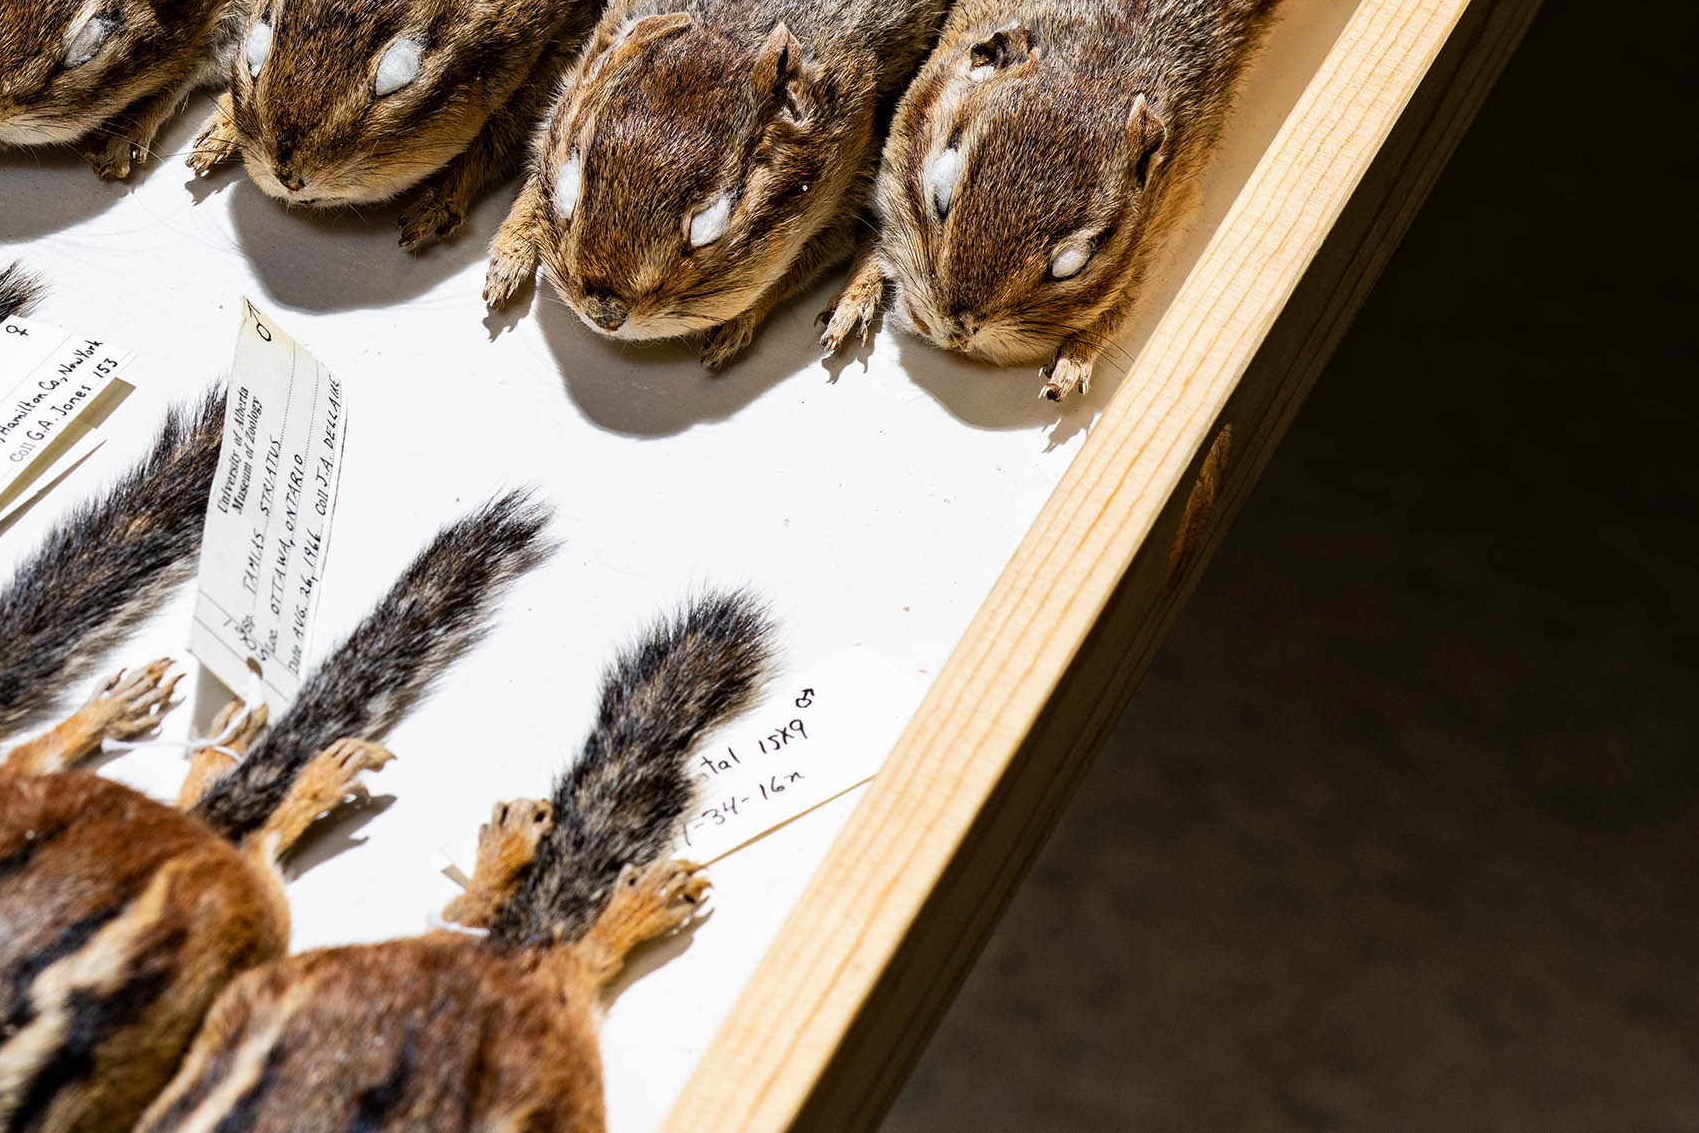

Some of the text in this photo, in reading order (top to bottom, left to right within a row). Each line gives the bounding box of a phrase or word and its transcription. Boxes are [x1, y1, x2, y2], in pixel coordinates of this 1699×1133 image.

[10, 442, 36, 462] Coll
[50, 385, 91, 416] Jones
[93, 358, 118, 378] 153
[217, 386, 250, 513] University of Alberta
[232, 395, 263, 515] Museum of Zoology
[243, 528, 264, 594] TAMIAS
[260, 434, 283, 517] STRIATUS
[270, 538, 296, 615] OTTAWA,
[286, 454, 303, 532] ONTARIO
[315, 489, 328, 516] Coll
